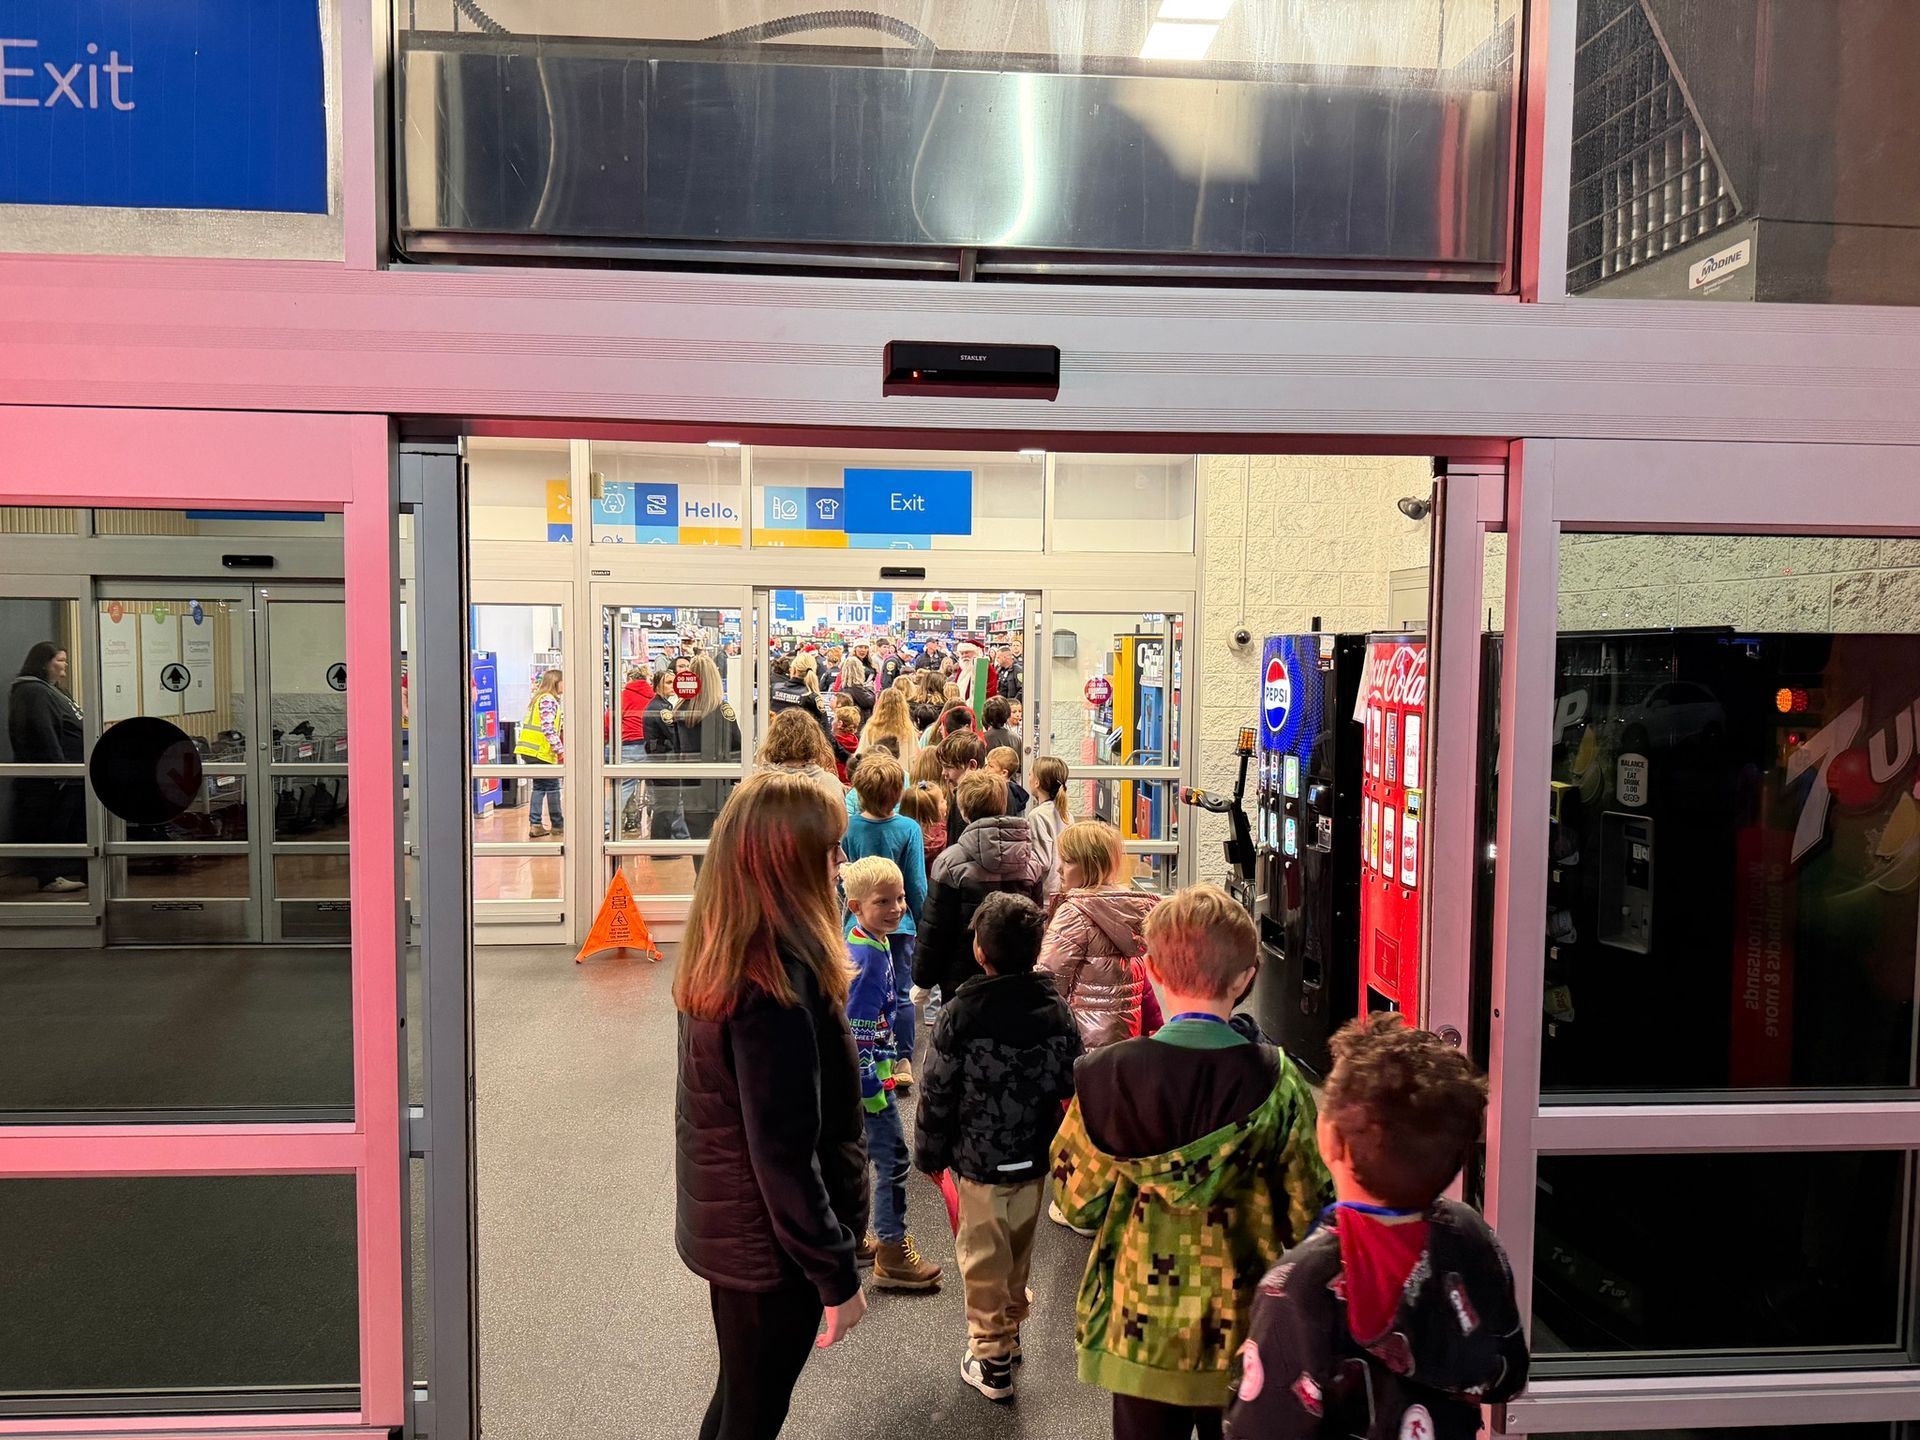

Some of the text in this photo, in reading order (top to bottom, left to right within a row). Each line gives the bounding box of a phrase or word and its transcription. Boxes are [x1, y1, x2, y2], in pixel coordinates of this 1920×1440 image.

[0, 38, 136, 111] Exit
[1698, 251, 1743, 280] MODINE
[960, 354, 987, 362] STANLEY
[685, 501, 739, 521] Hello,
[891, 493, 926, 511] Exit
[1370, 646, 1427, 706] ca-Cola
[1265, 687, 1288, 703] PEPSI
[1620, 760, 1645, 768] BALANCE
